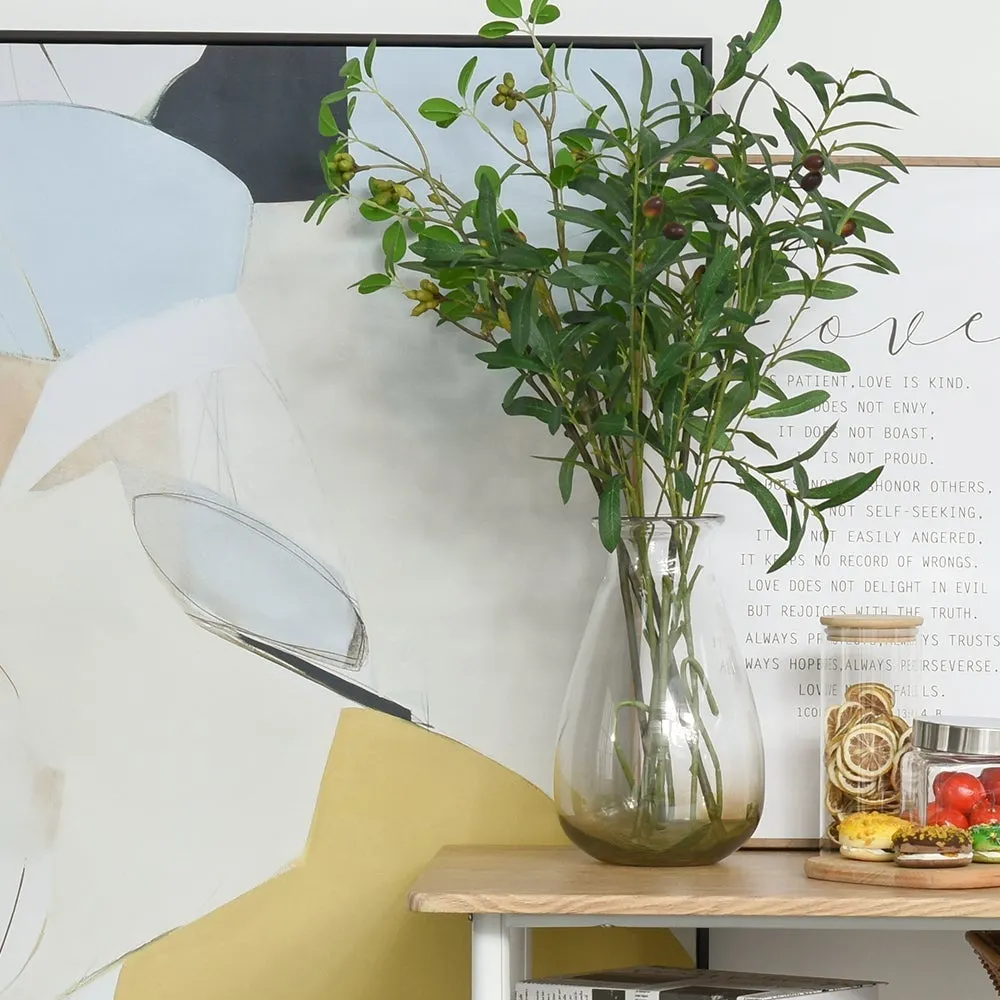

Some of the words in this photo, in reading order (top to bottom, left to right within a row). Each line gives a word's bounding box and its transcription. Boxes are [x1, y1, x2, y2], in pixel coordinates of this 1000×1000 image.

[903, 376, 919, 389] IS
[929, 376, 971, 391] KIND.
[858, 401, 884, 413] NOT
[779, 426, 794, 438] IT
[848, 427, 875, 438] NOT
[823, 452, 839, 464] IS
[848, 452, 875, 464] NOT
[884, 453, 935, 465] PROUD.
[829, 505, 855, 517] NOT
[756, 529, 772, 542] IT
[848, 531, 901, 544] EASILY
[740, 553, 756, 566] IT
[815, 554, 831, 567] NO
[840, 554, 889, 568] RECORD
[897, 555, 913, 568] OF
[922, 556, 979, 570] WRONGS.
[748, 579, 780, 592] LOVE
[789, 579, 822, 592] DOES
[831, 580, 855, 593] NOT
[864, 580, 921, 593] DELIGHT
[931, 581, 947, 594] IN
[956, 581, 988, 594] EVIL
[747, 604, 772, 617] BUT
[781, 605, 847, 618] REJOICES
[855, 606, 888, 616] WITH
[931, 606, 979, 620] TRUTH.
[745, 632, 798, 645] ALWAYS
